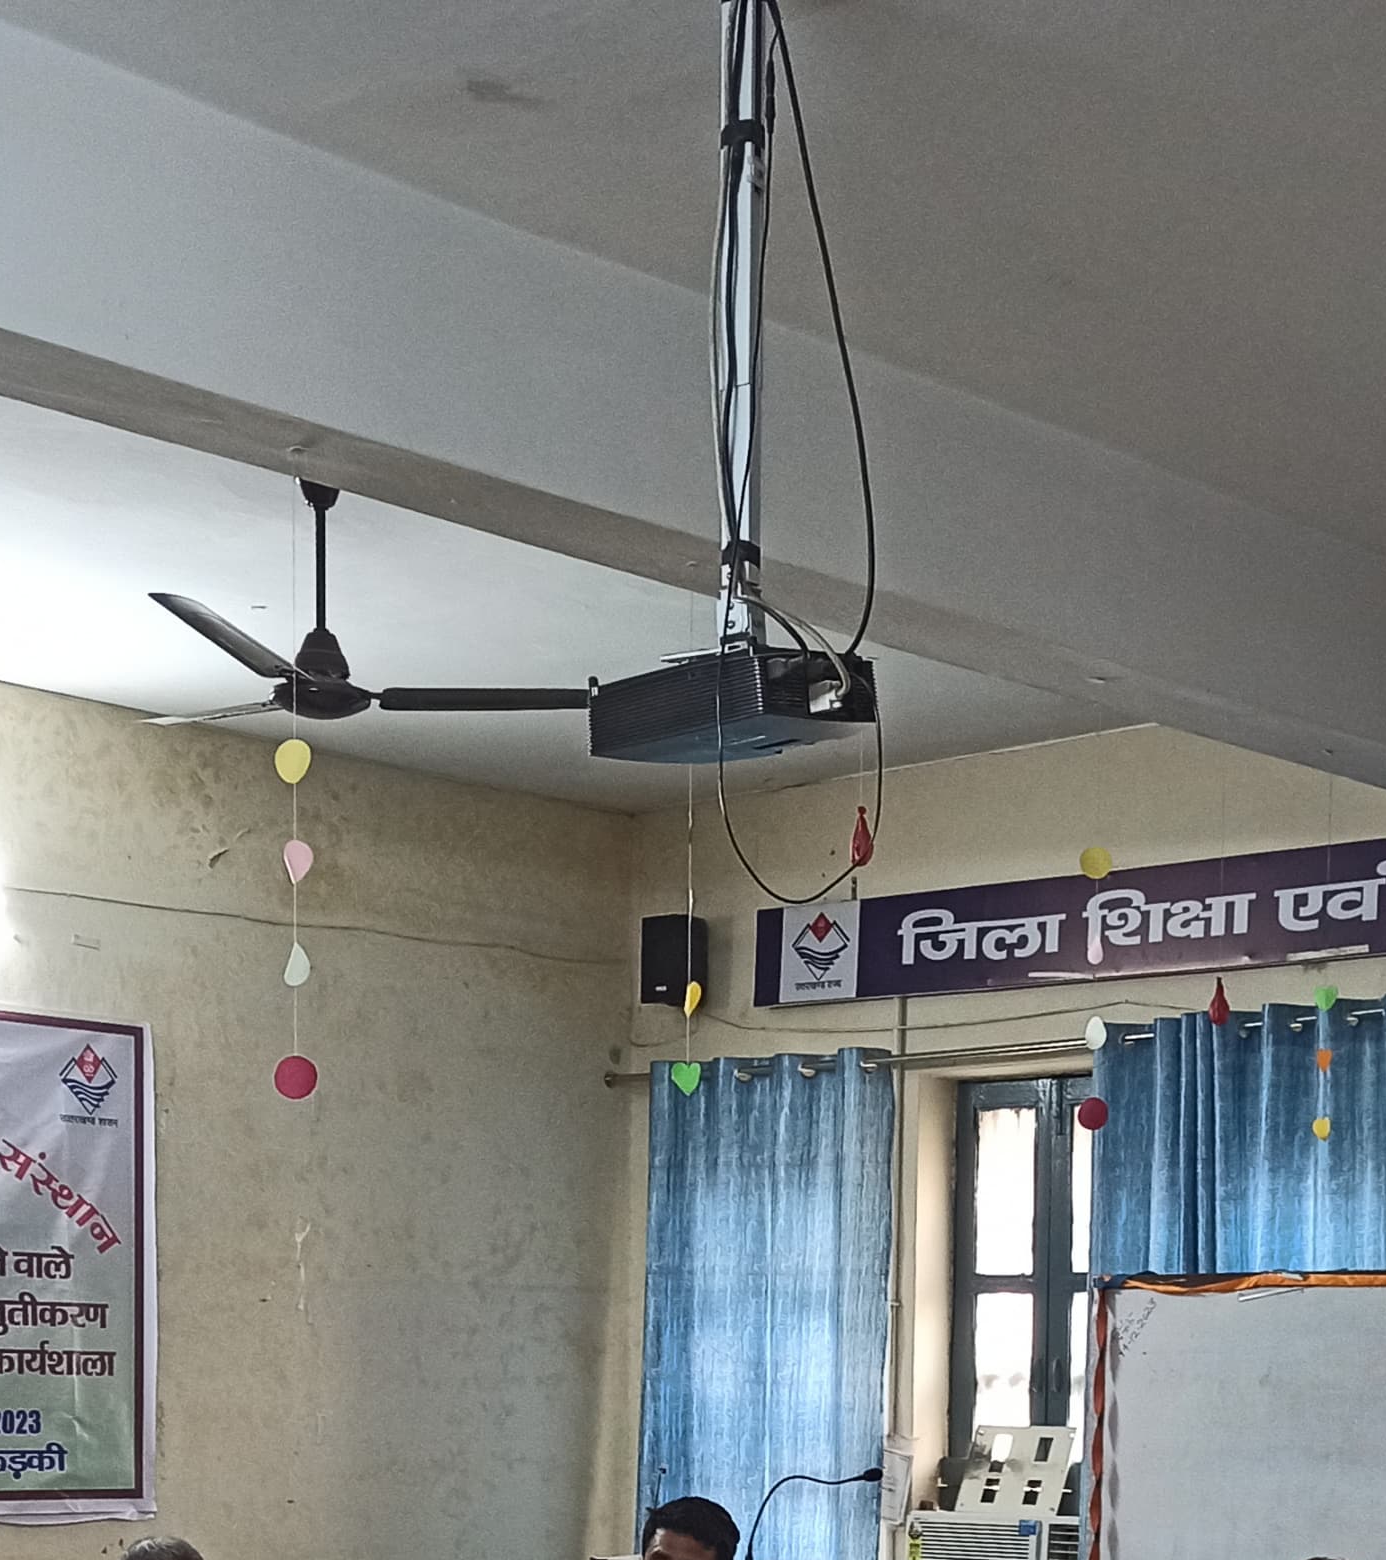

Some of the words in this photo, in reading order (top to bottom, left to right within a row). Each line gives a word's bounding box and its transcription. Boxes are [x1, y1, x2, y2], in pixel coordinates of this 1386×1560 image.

[897, 910, 1067, 966] जिला
[1083, 888, 1255, 950] शिक्षा
[13, 1246, 74, 1280] वाले
